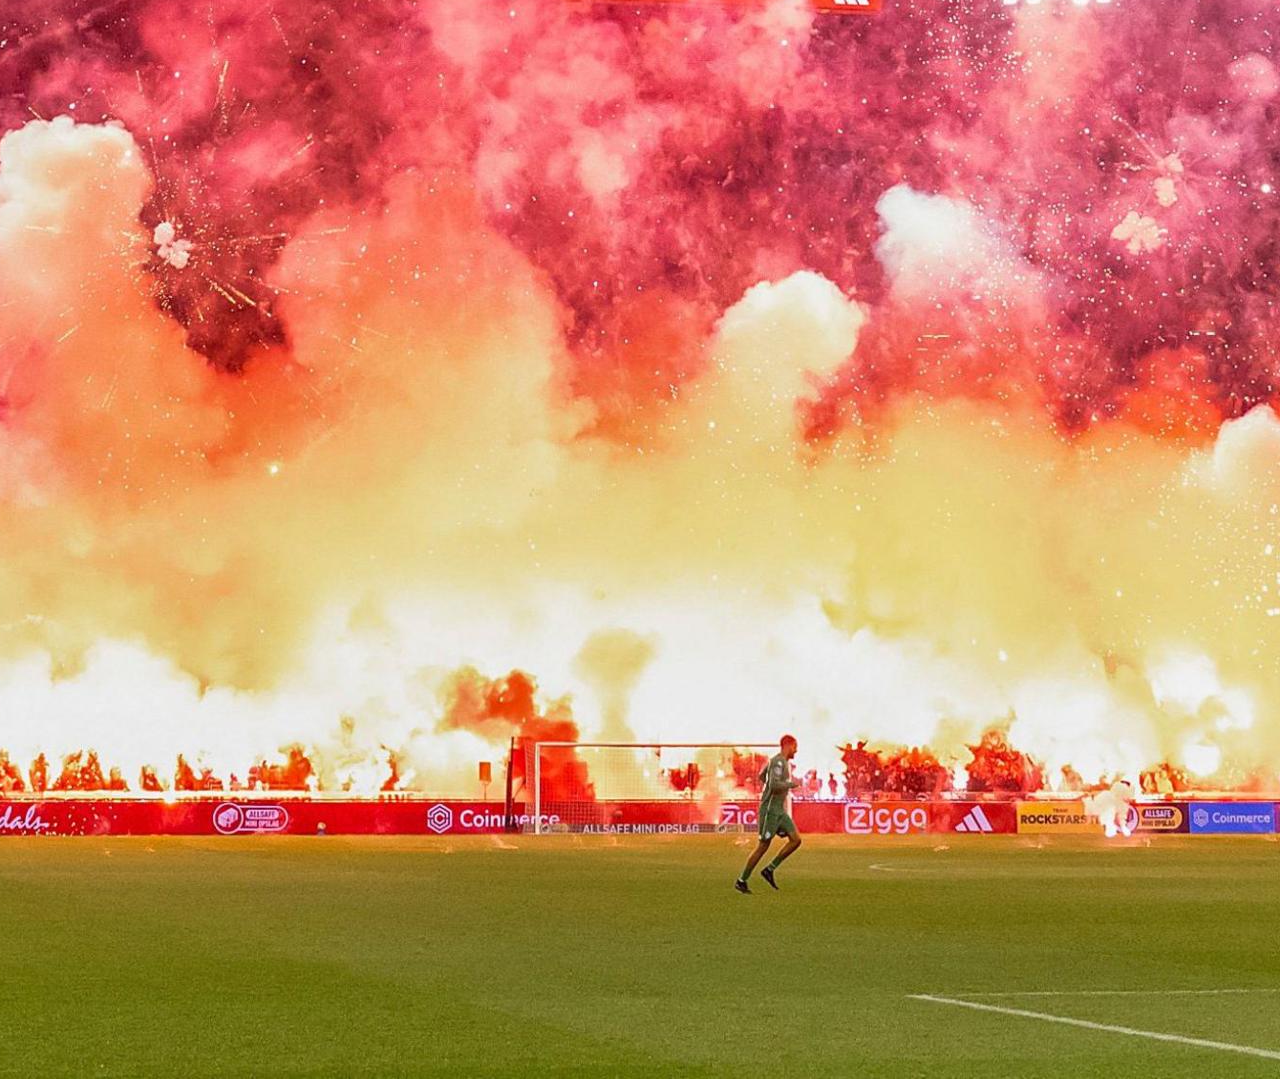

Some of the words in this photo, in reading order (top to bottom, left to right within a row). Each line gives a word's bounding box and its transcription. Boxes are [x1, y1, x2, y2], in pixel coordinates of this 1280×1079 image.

[1020, 814, 1088, 824] ROCKSTARS
[1212, 812, 1271, 824] Coinmerce
[582, 823, 631, 834] ALLSAFE
[633, 823, 657, 834] MINI
[658, 823, 700, 835] OPSLAG
